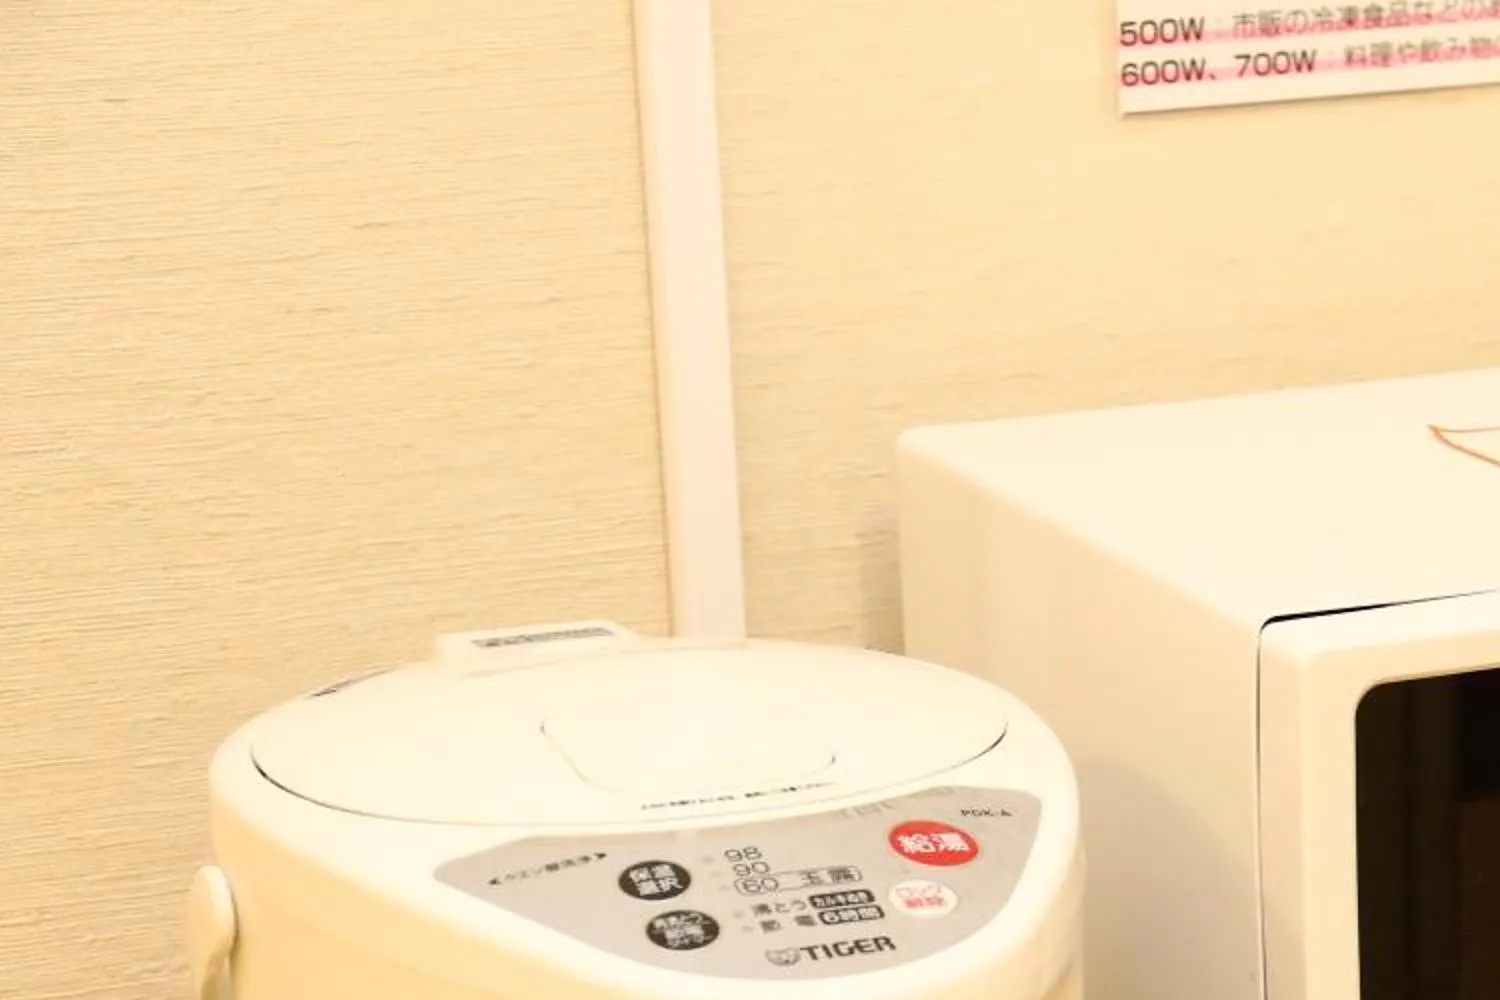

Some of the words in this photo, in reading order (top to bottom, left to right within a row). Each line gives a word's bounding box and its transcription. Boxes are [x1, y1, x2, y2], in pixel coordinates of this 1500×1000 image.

[1120, 16, 1205, 47] 500W
[1234, 49, 1317, 77] 700W
[724, 846, 763, 862] 98
[733, 861, 770, 877] 90
[743, 876, 779, 893] 60
[800, 935, 896, 961] TIGER
